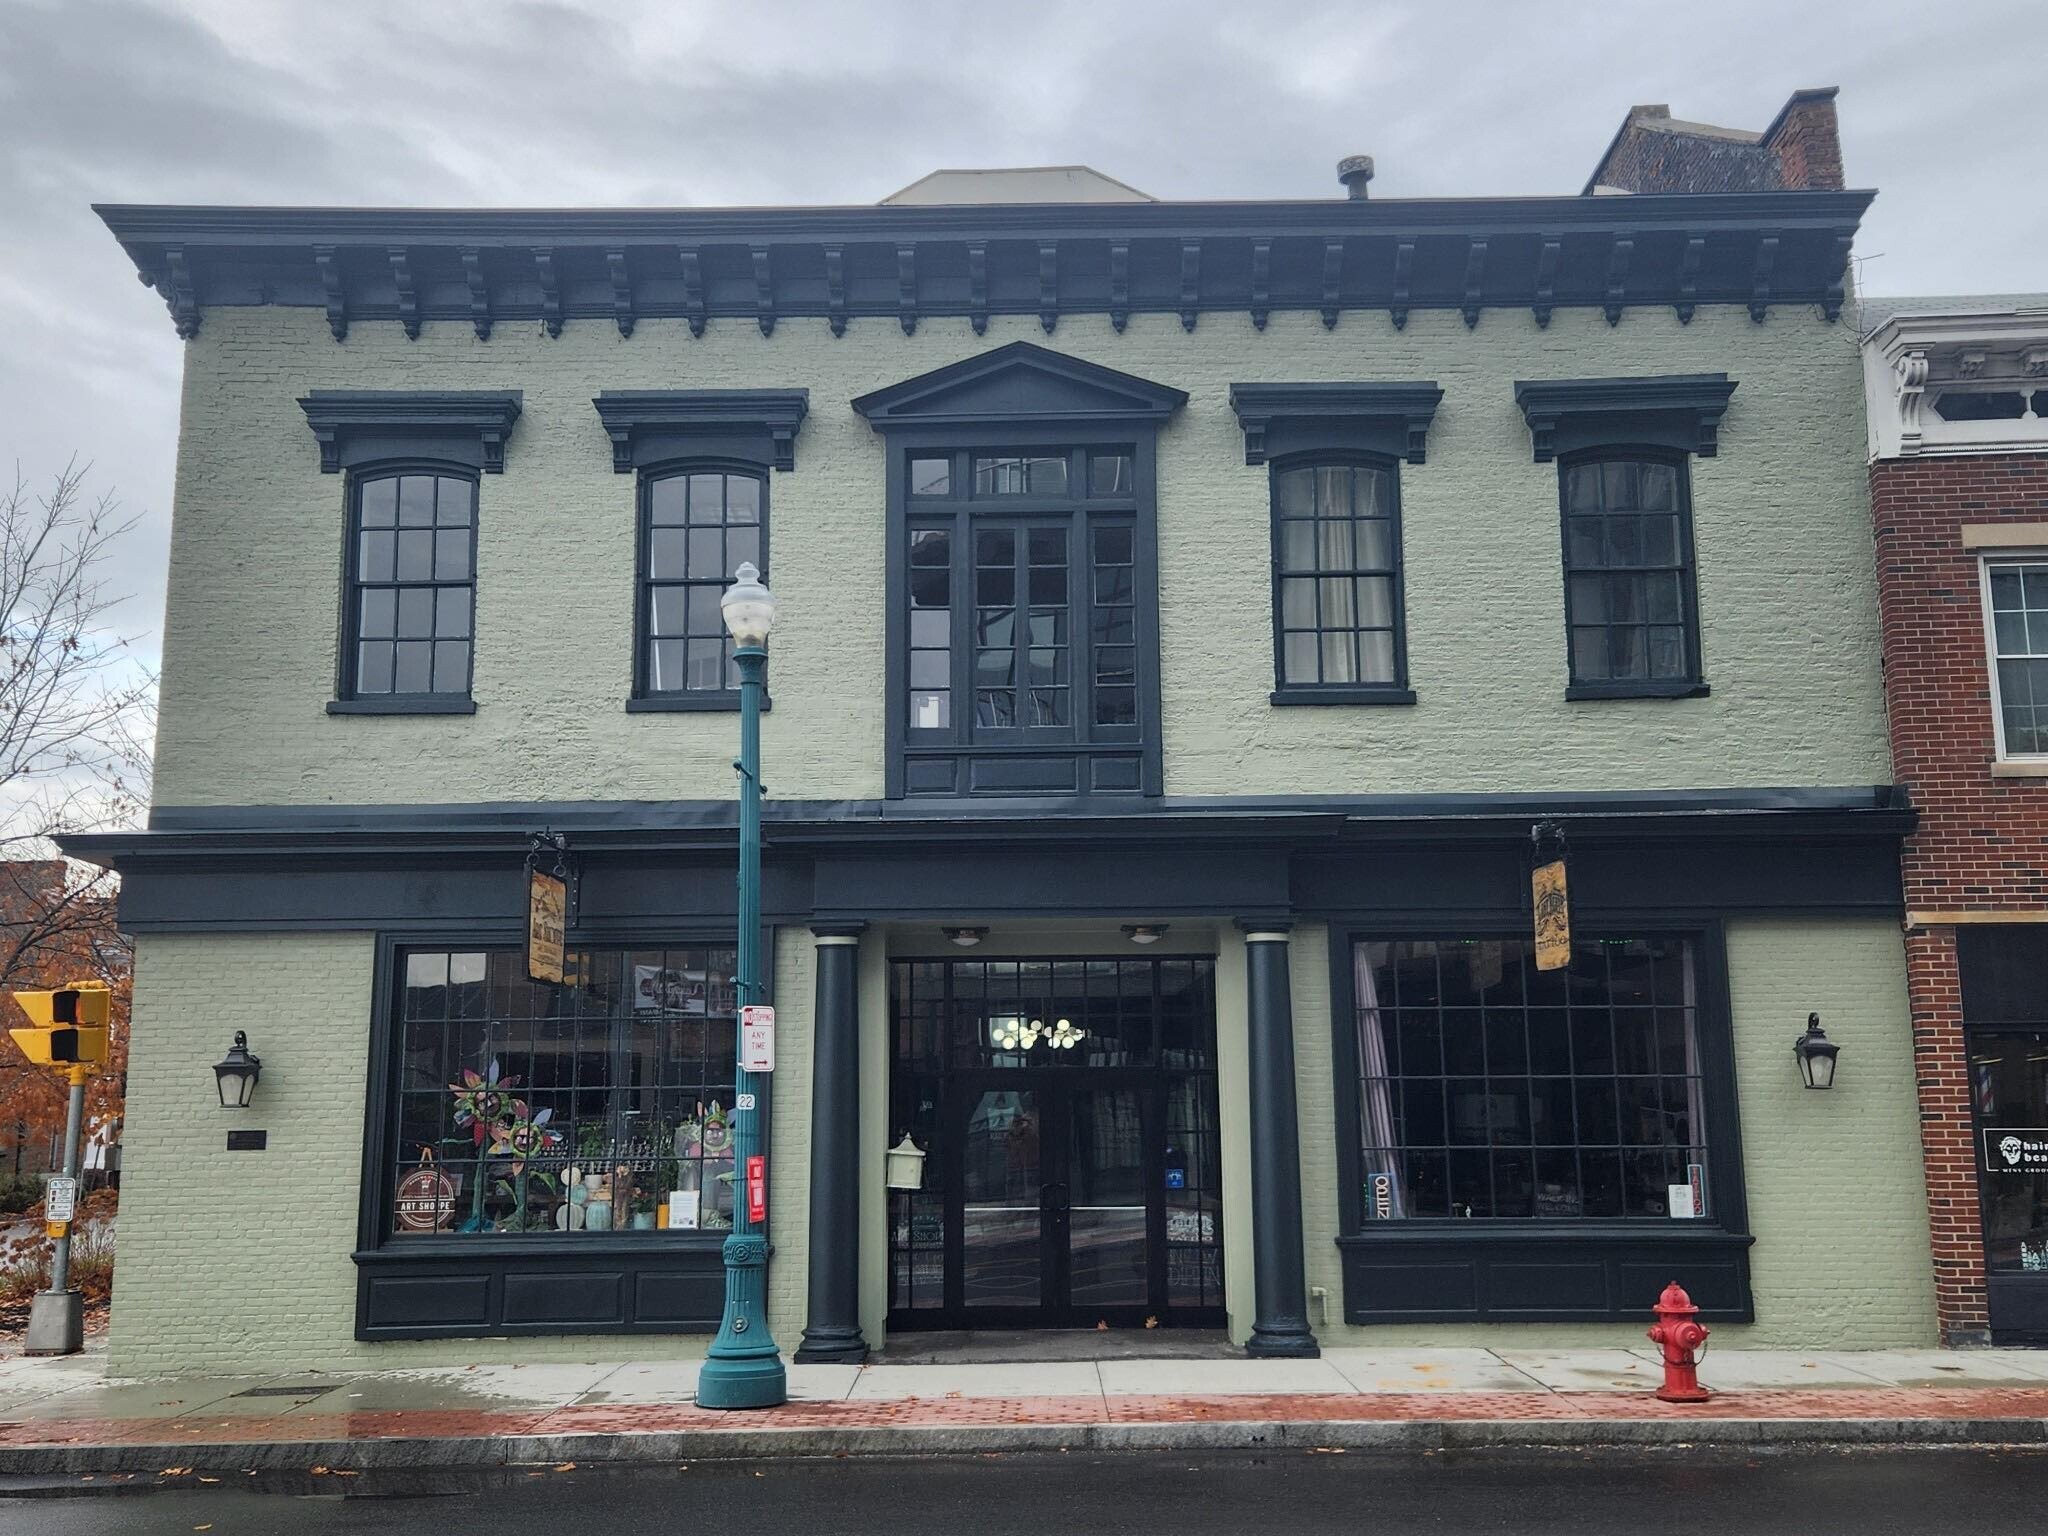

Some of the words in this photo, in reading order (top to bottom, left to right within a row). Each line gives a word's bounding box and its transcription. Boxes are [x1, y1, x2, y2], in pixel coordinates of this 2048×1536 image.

[752, 1031, 765, 1039] ANY
[739, 1095, 753, 1108] 22
[1375, 1176, 1389, 1219] OPEN
[401, 1202, 417, 1211] ART
[419, 1201, 450, 1210] SHOPE
